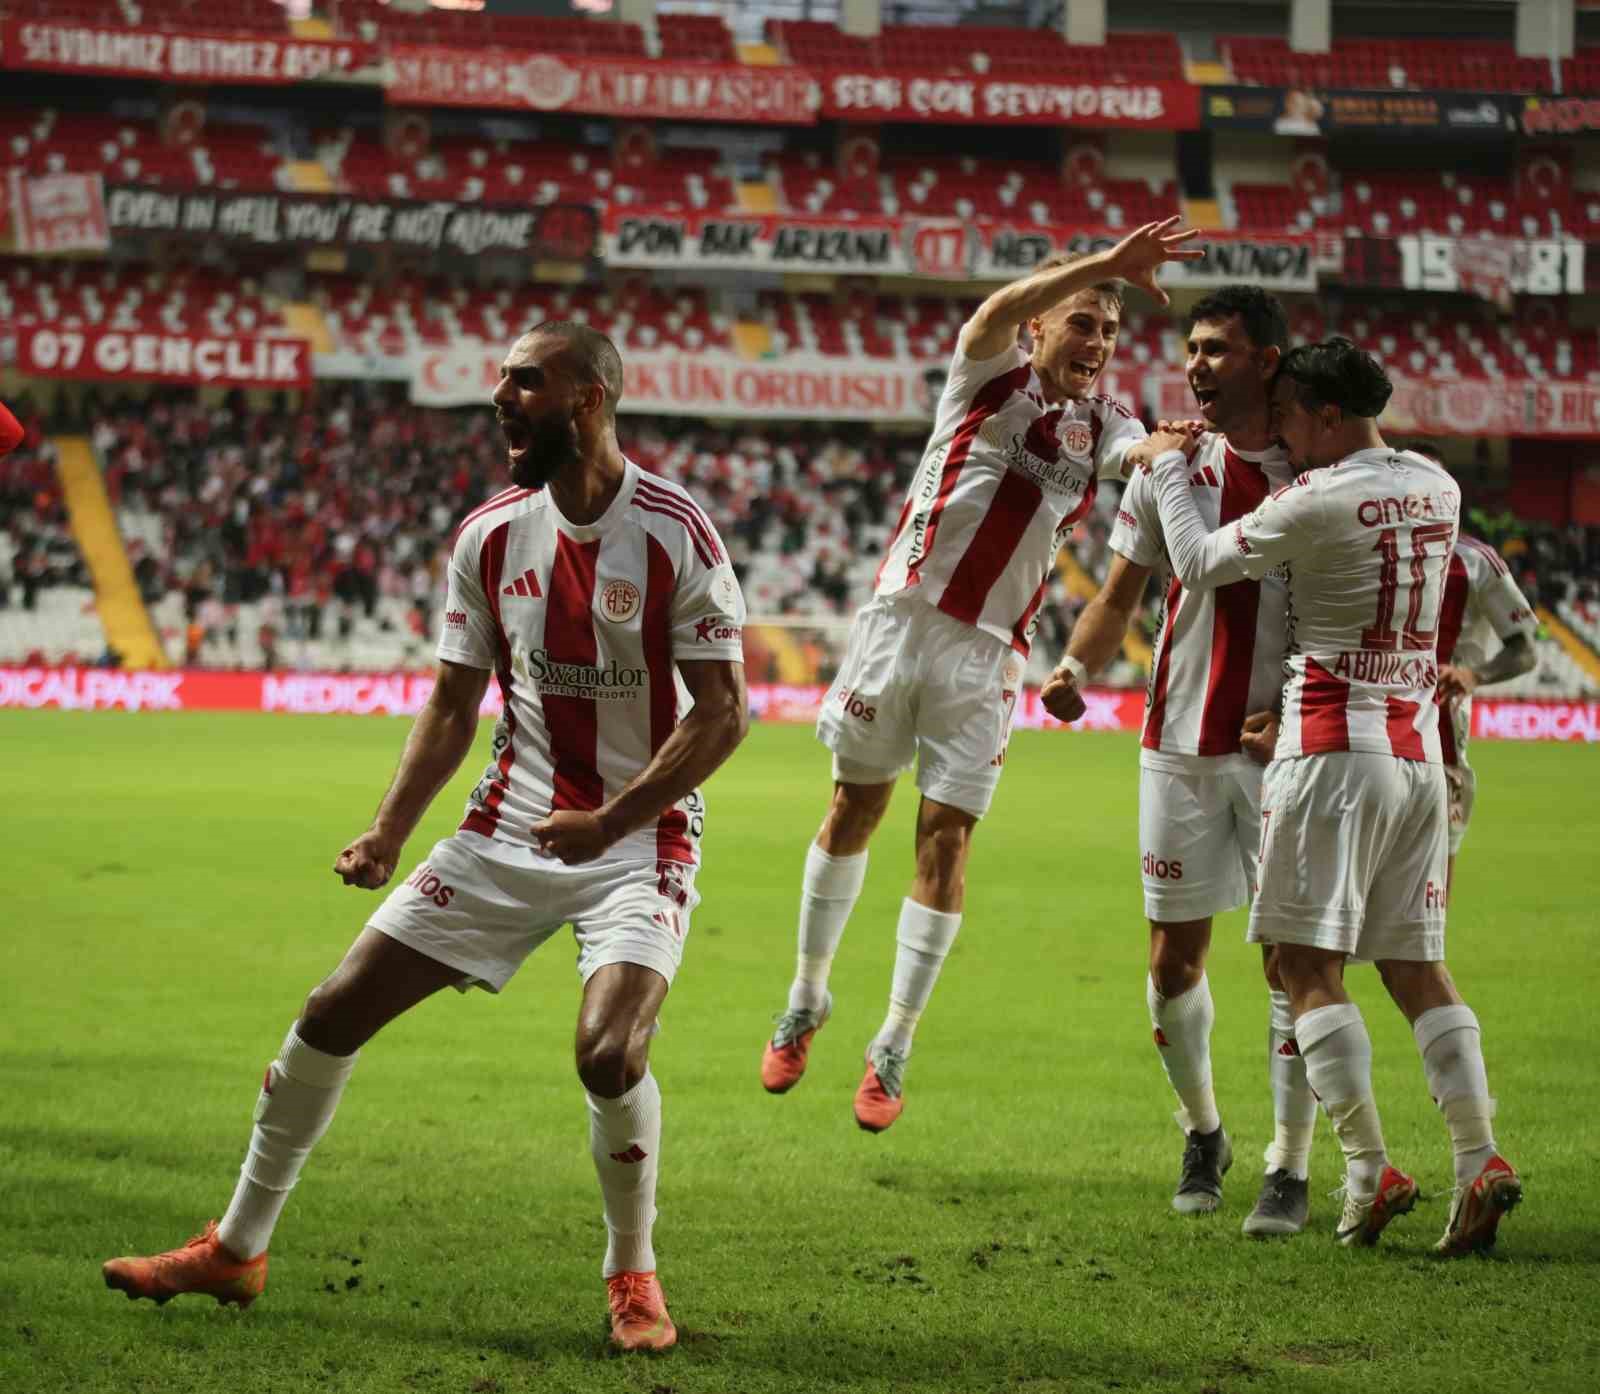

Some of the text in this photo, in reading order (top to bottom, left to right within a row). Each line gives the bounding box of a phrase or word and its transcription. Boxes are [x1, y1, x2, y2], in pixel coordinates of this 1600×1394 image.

[181, 197, 216, 231] IN
[31, 329, 85, 370] 07
[734, 362, 910, 412] ORDUSU
[528, 648, 649, 688] Swandor
